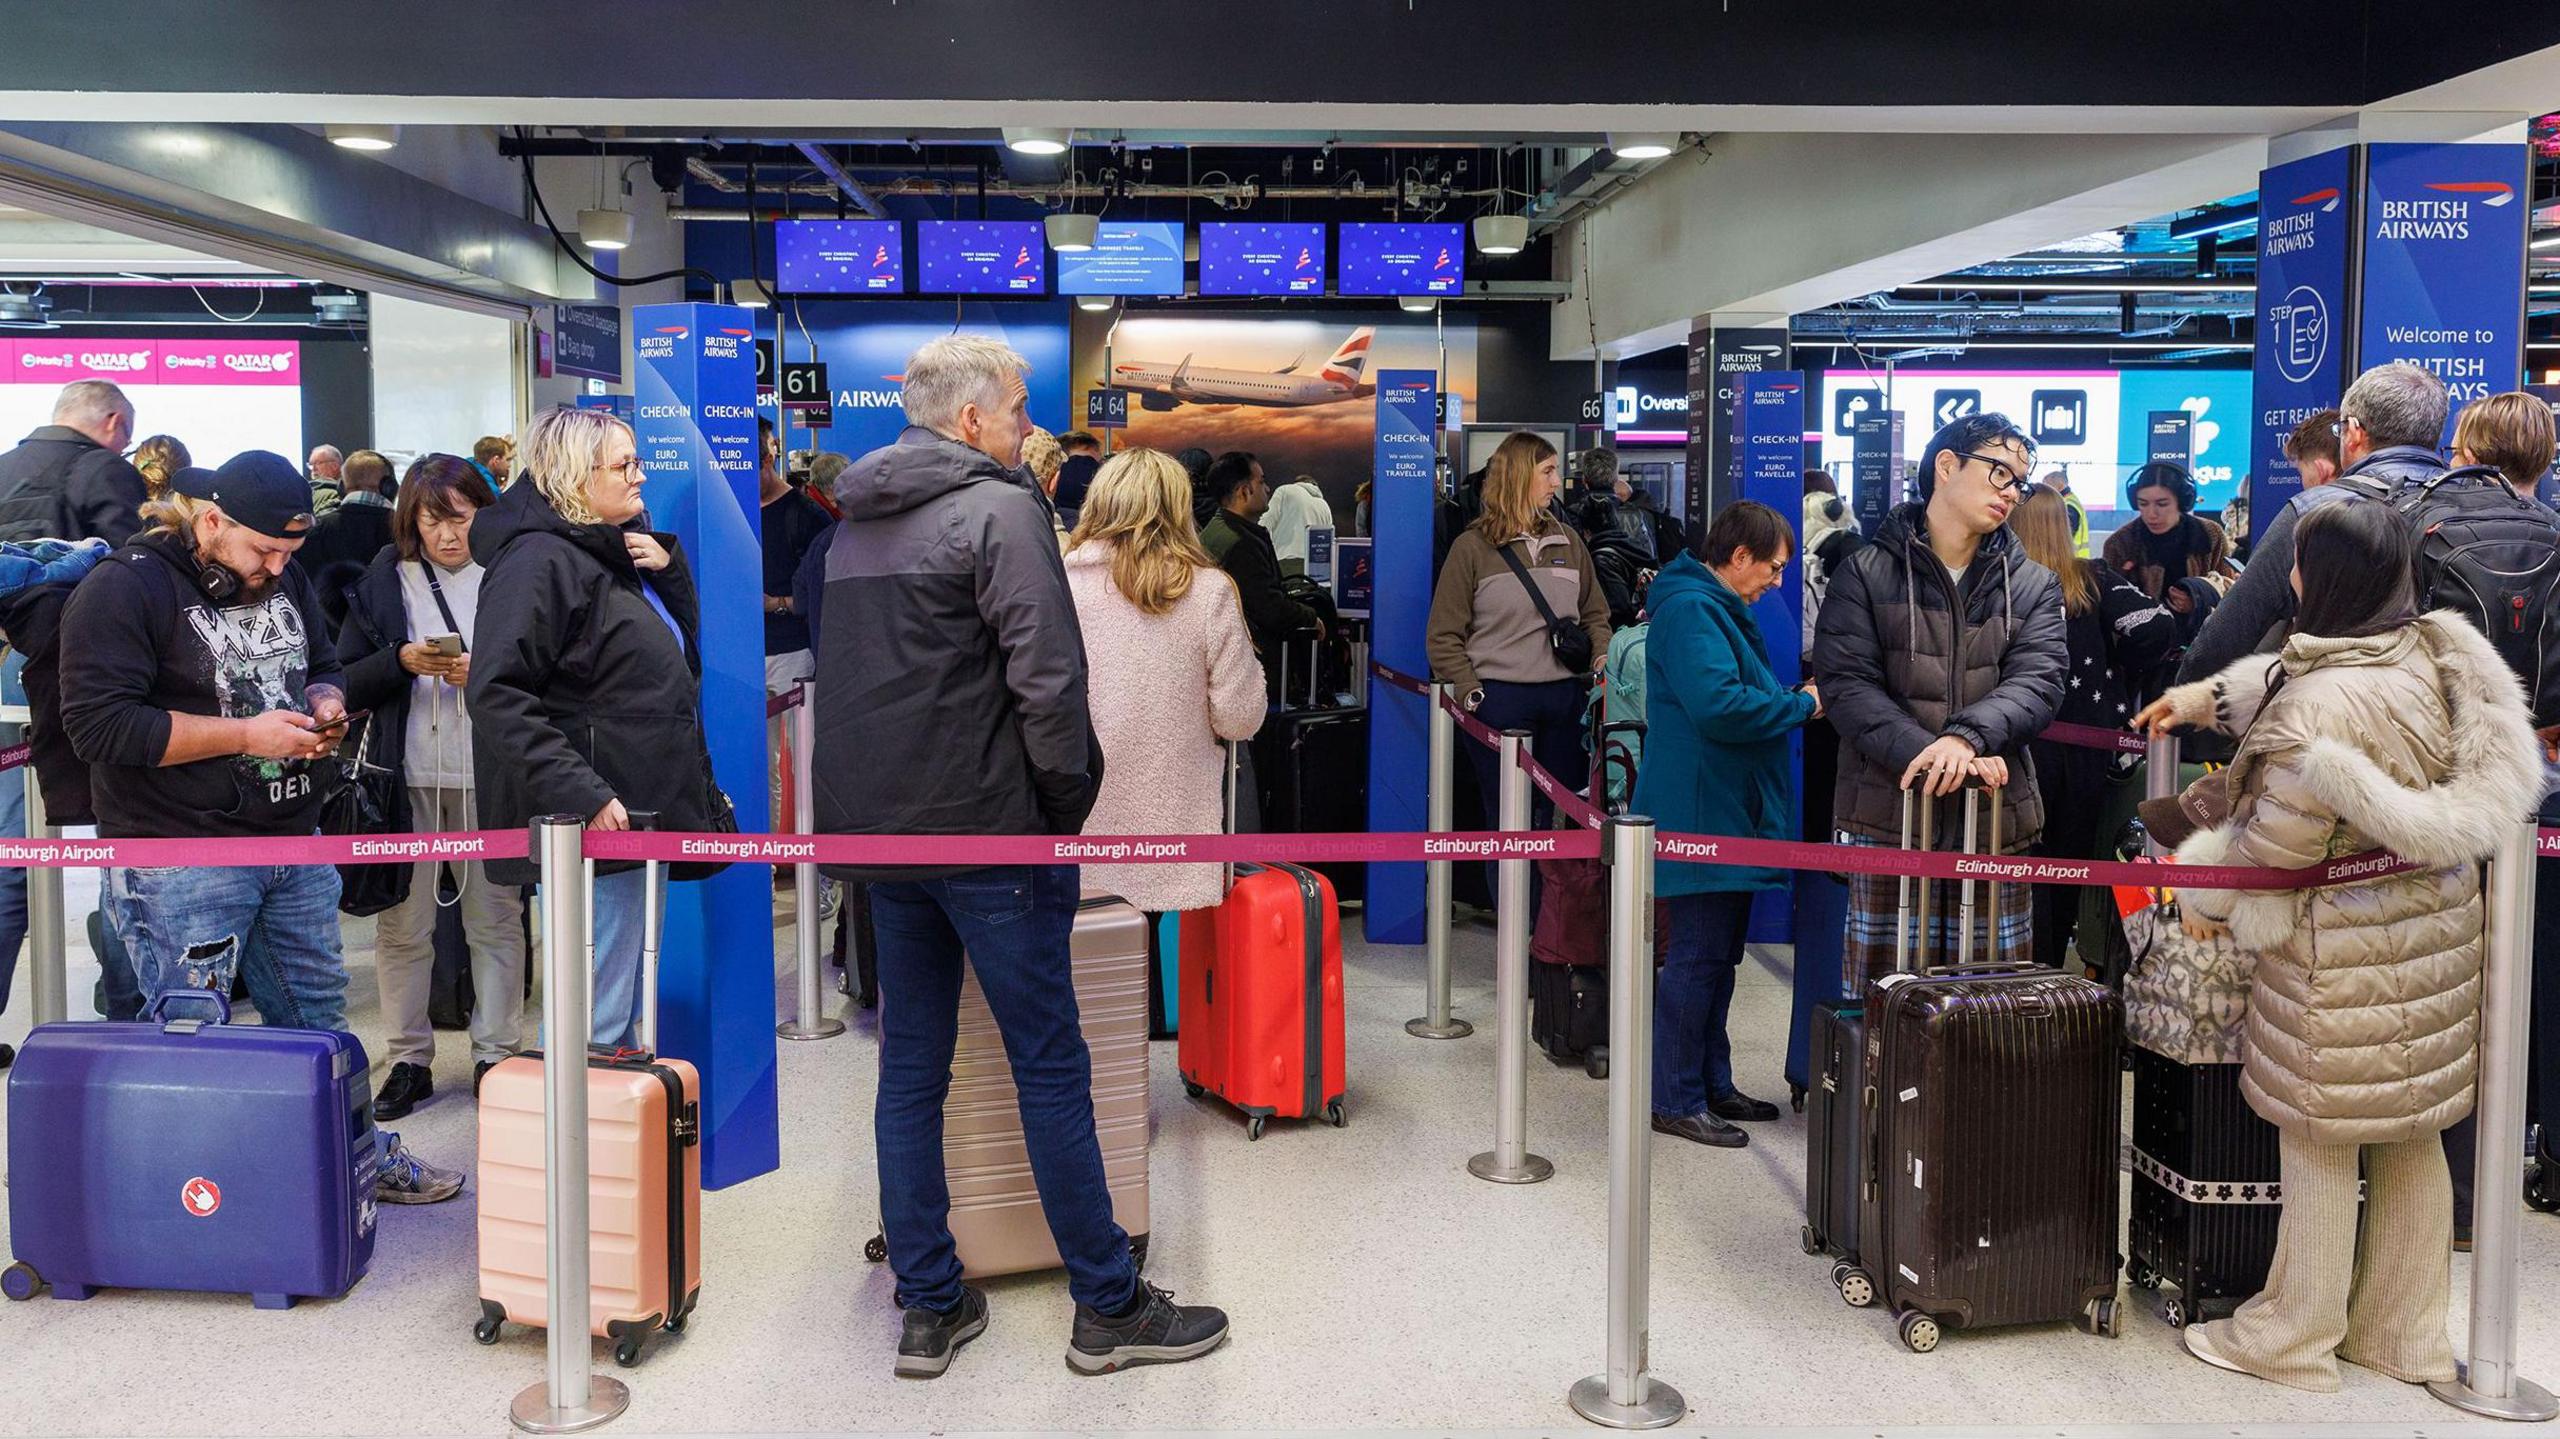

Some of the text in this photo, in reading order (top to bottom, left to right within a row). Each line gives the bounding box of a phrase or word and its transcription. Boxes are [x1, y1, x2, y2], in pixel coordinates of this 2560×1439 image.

[2383, 201, 2468, 219] BRITISH
[2268, 211, 2314, 238] BRITISH
[2377, 221, 2469, 240] AIRWAYS
[2265, 231, 2315, 257] AIRWAYS
[2270, 305, 2292, 321] STEP
[2274, 321, 2279, 344] 1
[2386, 326, 2494, 343] Welcome to
[568, 337, 595, 362] Bag drop
[640, 338, 673, 348] BRITISH
[705, 337, 737, 348] BRITISH
[80, 353, 129, 367] QATAR
[224, 354, 272, 368] QATAR
[639, 348, 673, 358] AIRWAYS
[704, 347, 738, 359] AIRWAYS
[1721, 354, 1761, 363] BRITISH
[755, 349, 766, 376] 0
[1719, 363, 1762, 372] AIRWAYS
[787, 370, 817, 394] 61
[838, 390, 904, 408] AIRWA
[1386, 389, 1416, 397] BRITISH
[640, 405, 690, 418] CHECK-IN
[705, 405, 754, 418] CHECK-IN
[1090, 396, 1103, 415] 64
[1109, 396, 1125, 415] 64
[1436, 399, 1443, 417] 5
[1582, 400, 1600, 419] 66
[1640, 395, 1689, 411] Oversi
[2264, 409, 2286, 426] GET
[647, 435, 686, 444] We welcome
[711, 434, 749, 444] We welcome
[1383, 434, 1430, 443] CHECK-IN
[1752, 435, 1799, 444] CHECK-IN
[655, 450, 678, 459] EURO
[720, 450, 742, 459] EURO
[644, 461, 689, 471] TRAVELLER
[709, 461, 753, 471] TRAVELLER
[1385, 470, 1427, 478] TRAVELLER
[2119, 736, 2147, 750] Edinbur
[2193, 798, 2210, 820] Kim
[0, 844, 115, 862] inburgh Airport
[352, 837, 484, 856] Edinburgh Airport
[682, 839, 815, 858] Edinburgh Airport
[1054, 841, 1187, 859] Edinburgh Airport
[1424, 837, 1556, 855] Edinburgh Airport
[1664, 838, 1718, 857] Airport
[1955, 859, 2090, 880] Edinburgh Airport
[2327, 854, 2393, 880] Edinburgh
